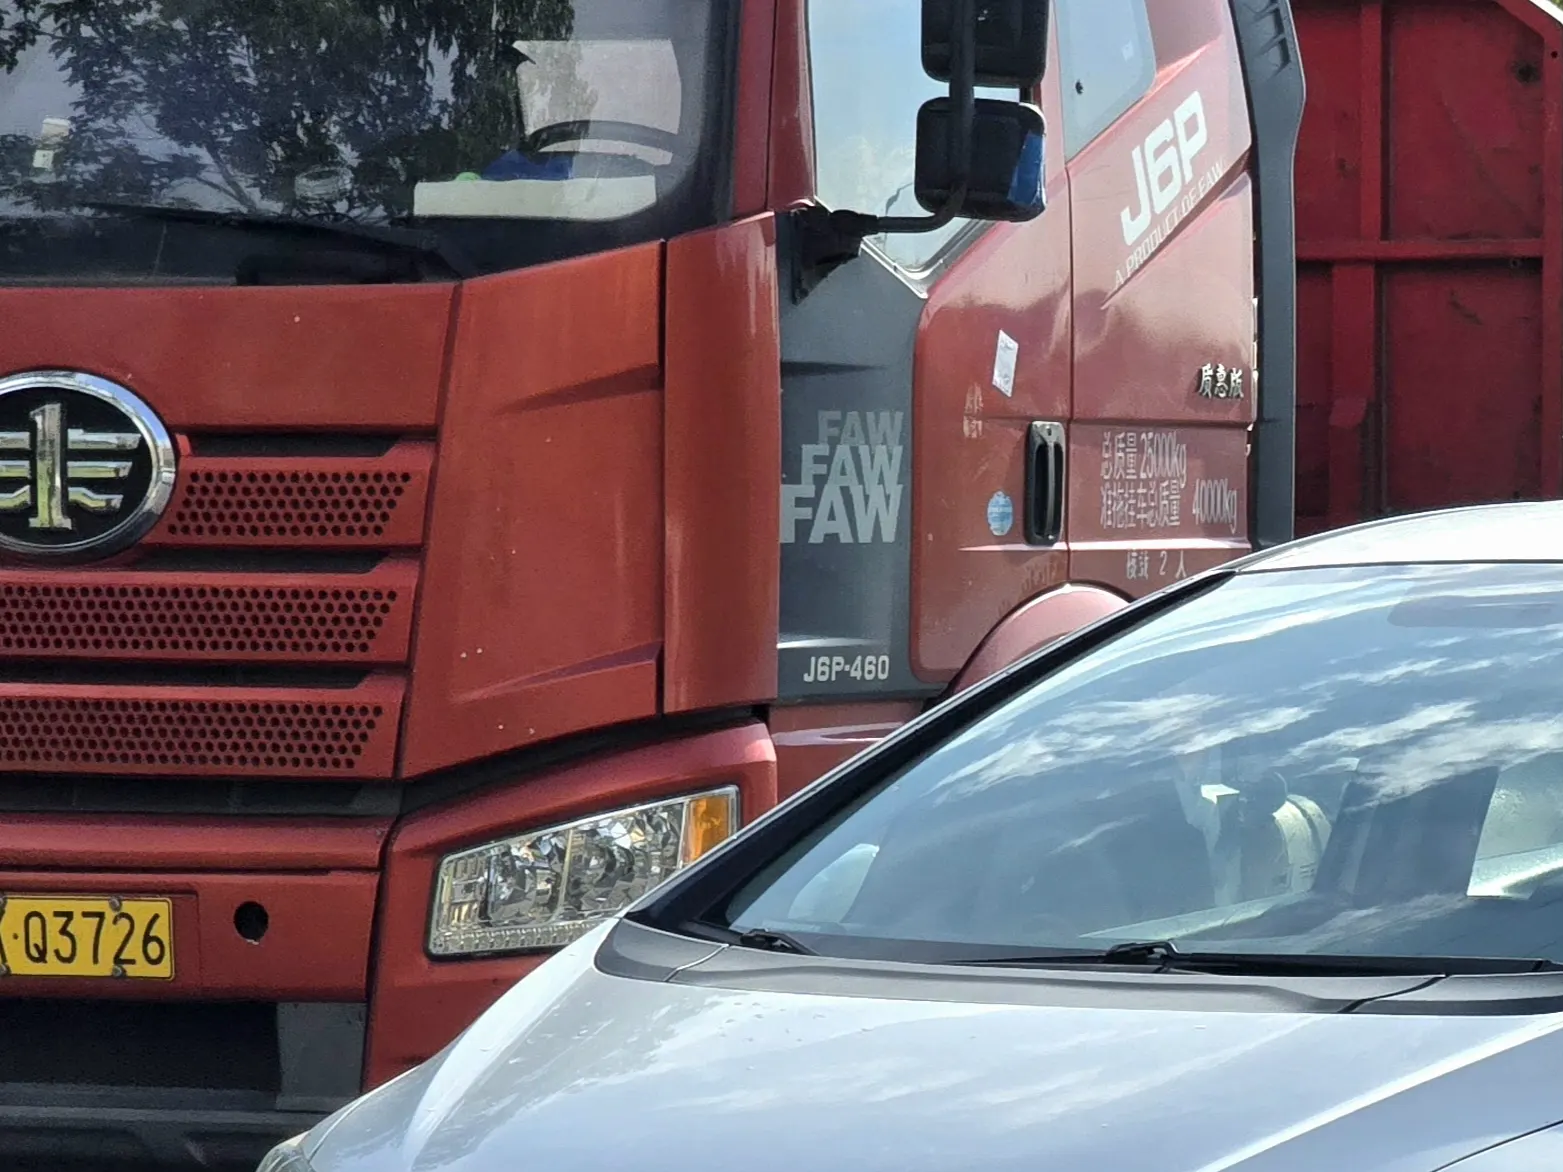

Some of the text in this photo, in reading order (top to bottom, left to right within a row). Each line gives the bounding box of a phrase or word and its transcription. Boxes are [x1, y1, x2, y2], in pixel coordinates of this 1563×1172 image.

[1120, 90, 1208, 246] J6P
[817, 410, 904, 445] FAW
[800, 444, 904, 491] FAW
[780, 484, 904, 544] FAW
[803, 655, 890, 683] J6P-460
